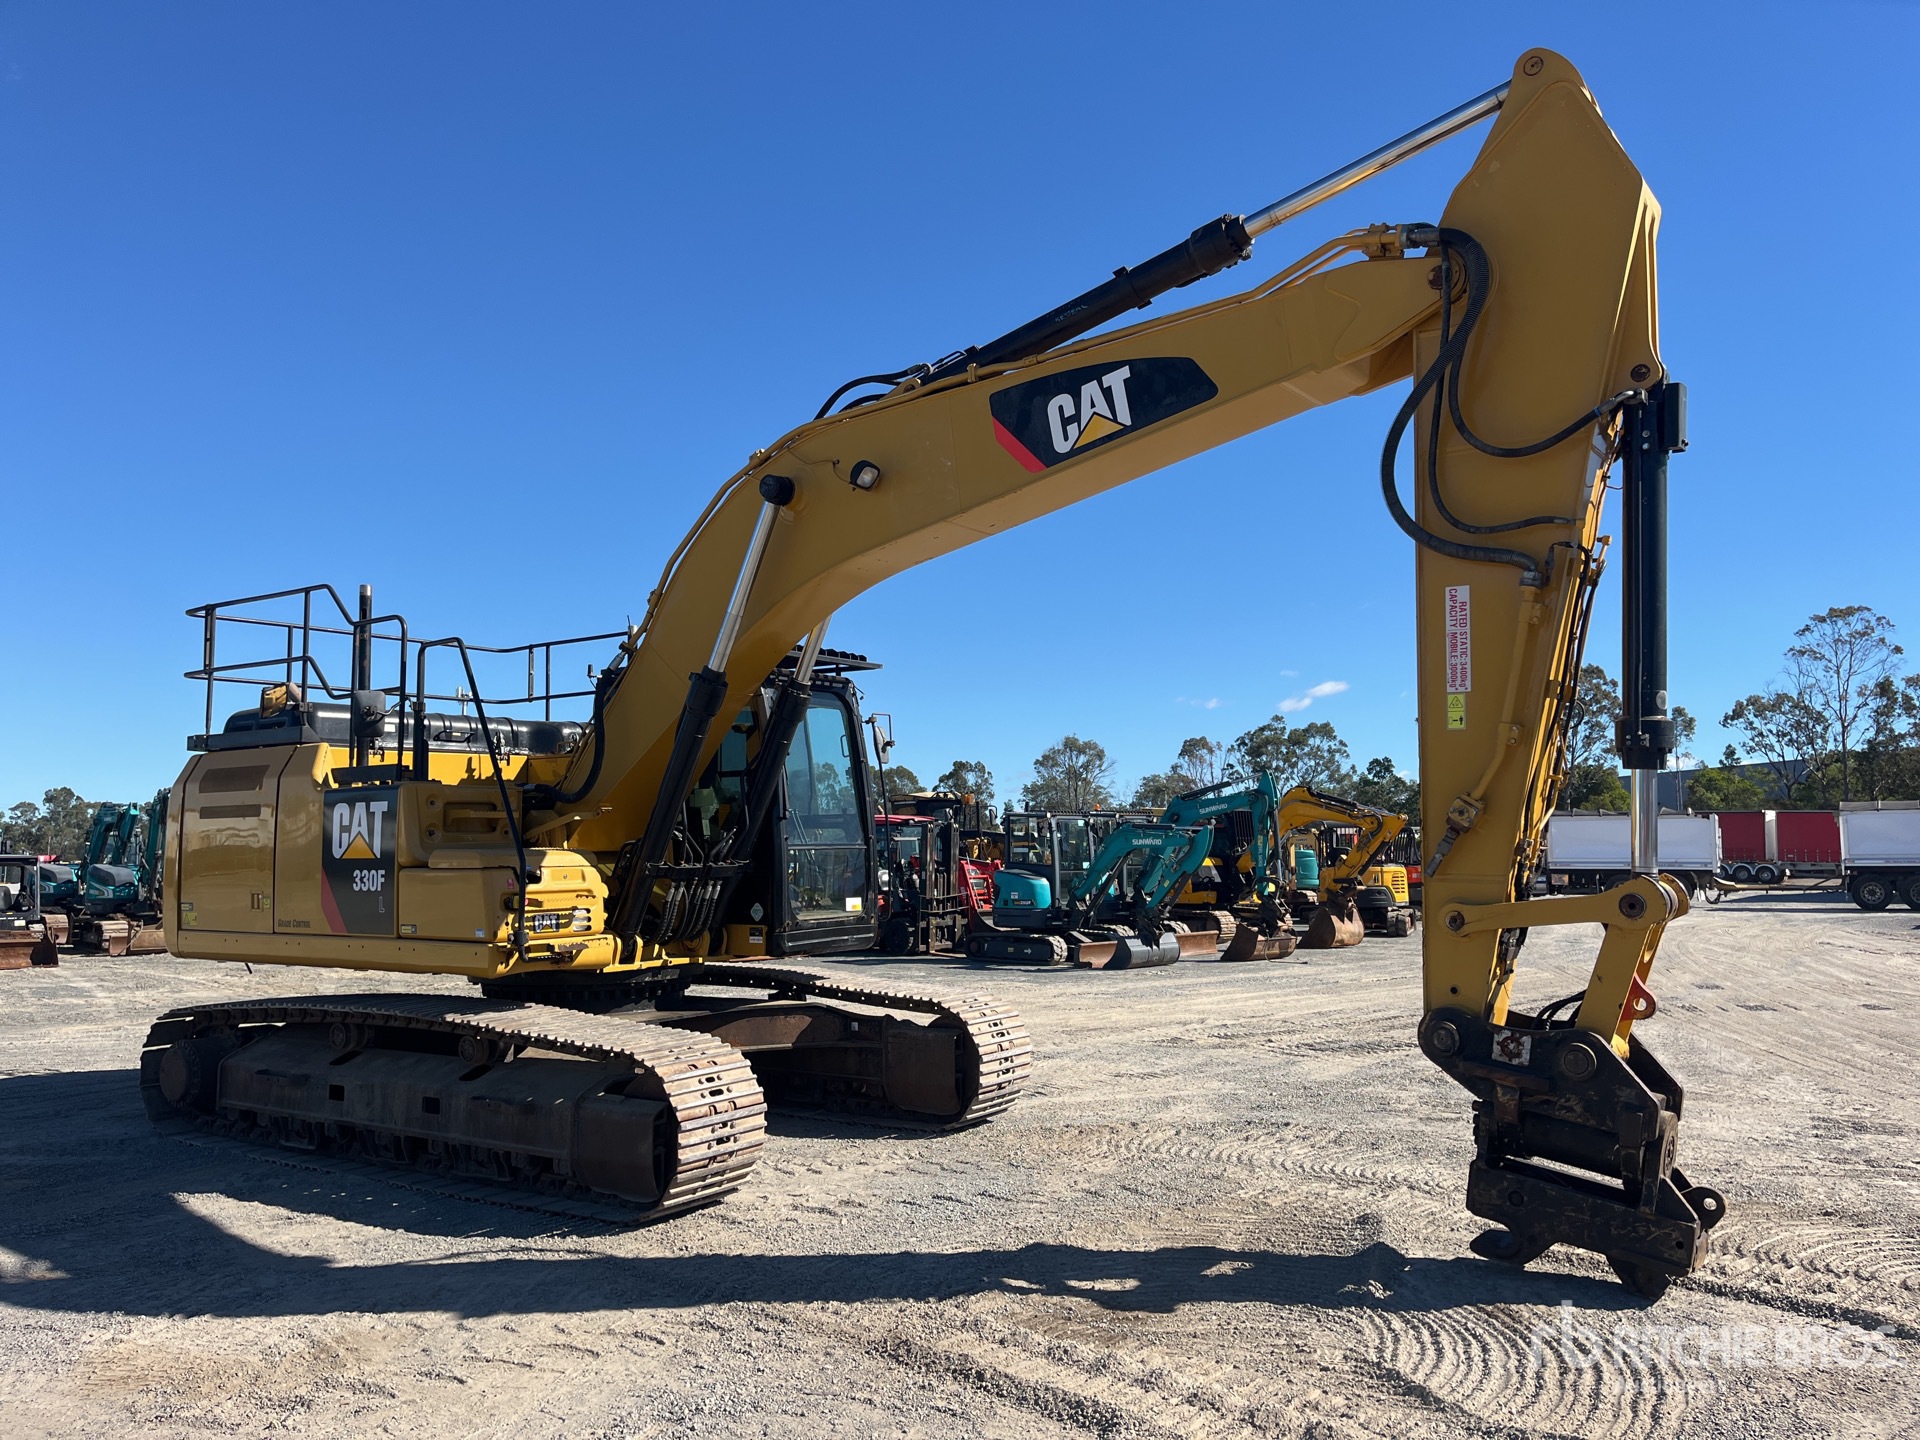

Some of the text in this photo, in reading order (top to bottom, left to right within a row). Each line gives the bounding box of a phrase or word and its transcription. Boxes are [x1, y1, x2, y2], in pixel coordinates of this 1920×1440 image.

[1047, 364, 1133, 454] CAT
[1449, 588, 1458, 628] CAPACITY
[1459, 601, 1468, 628] RATED
[1199, 803, 1228, 815] SUNWARD
[332, 801, 388, 859] CAT
[1132, 837, 1162, 846] SUNWARD
[352, 869, 386, 892] 330F
[378, 896, 386, 913] L
[535, 914, 557, 932] CAT
